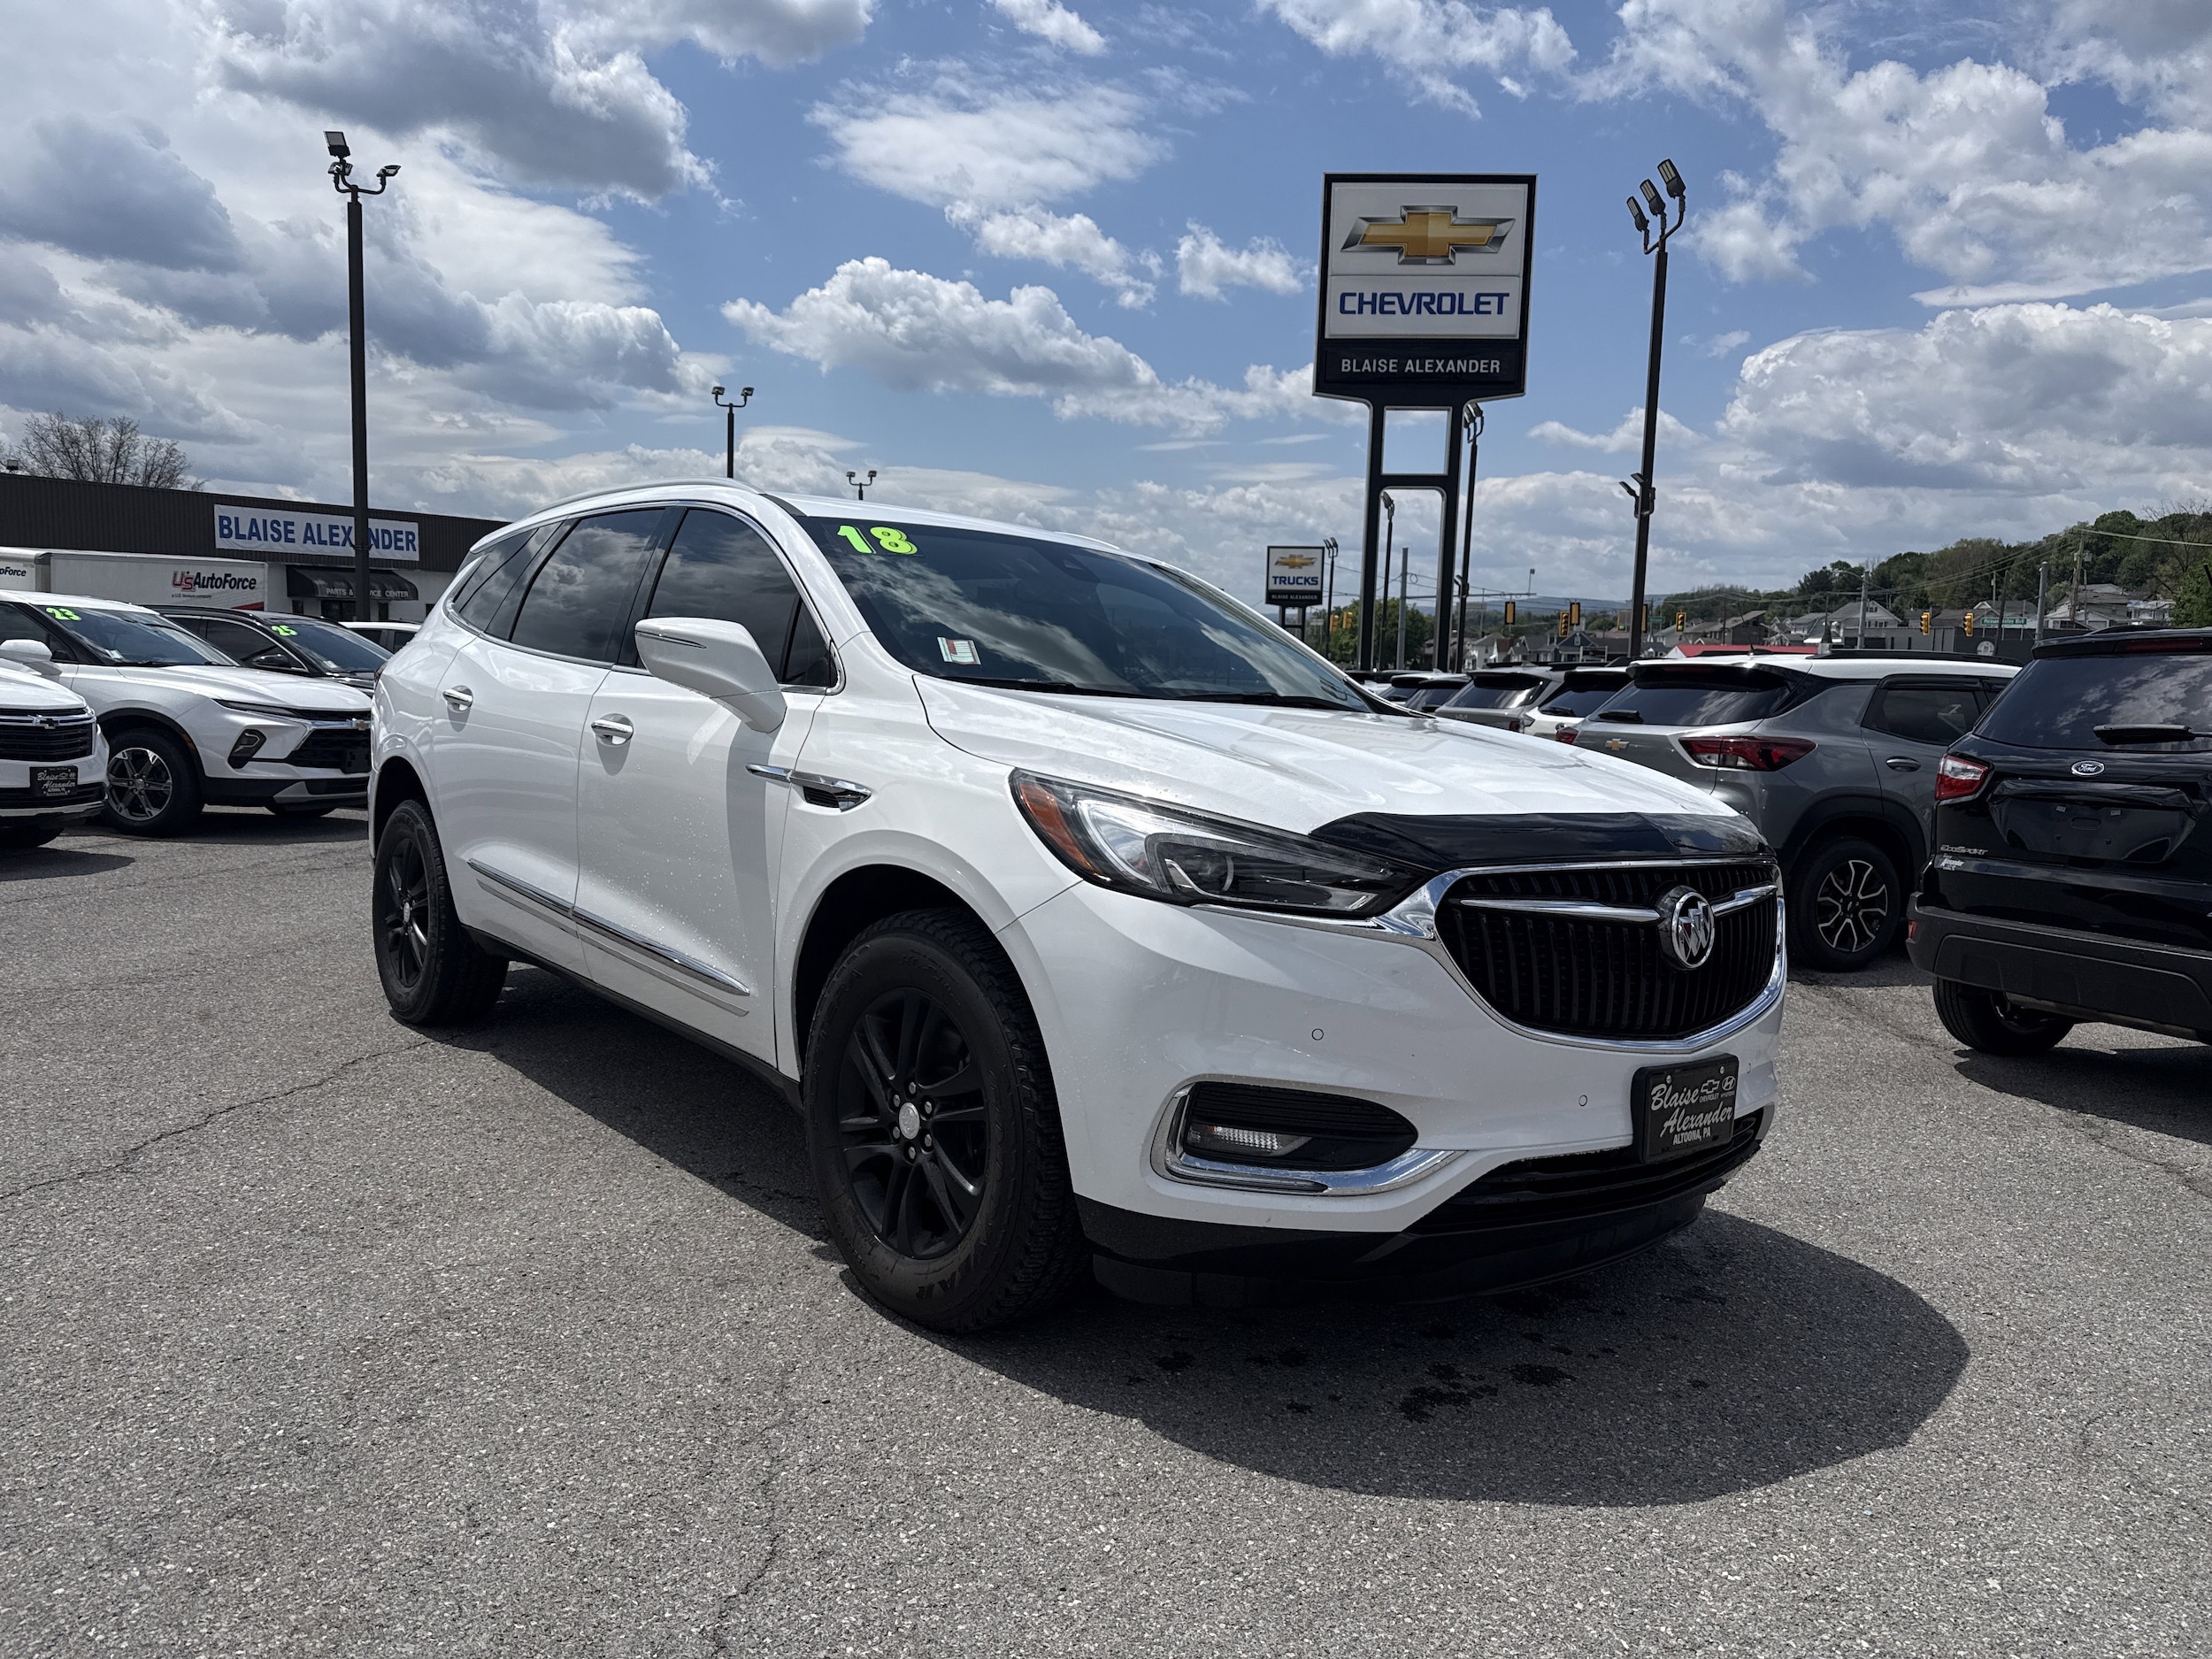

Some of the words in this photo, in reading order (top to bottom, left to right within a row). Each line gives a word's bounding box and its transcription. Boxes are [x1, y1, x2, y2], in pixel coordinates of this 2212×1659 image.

[1339, 292, 1510, 315] CHEVROLET
[1340, 358, 1399, 373] BLAISE
[1403, 358, 1501, 373] ALEXANDER
[219, 515, 296, 543] BLAISE
[303, 522, 418, 552] ALEXNDER
[837, 525, 918, 555] 18
[1271, 576, 1319, 586] TRUCKS
[326, 588, 347, 596] PARTS
[384, 589, 410, 598] CENTER
[46, 607, 82, 621] 23
[272, 625, 298, 637] 25
[37, 772, 58, 780] Blaise
[1650, 1083, 1700, 1111] Blaise
[1659, 1101, 1733, 1138] Alexander
[1702, 1126, 1711, 1138] PA
